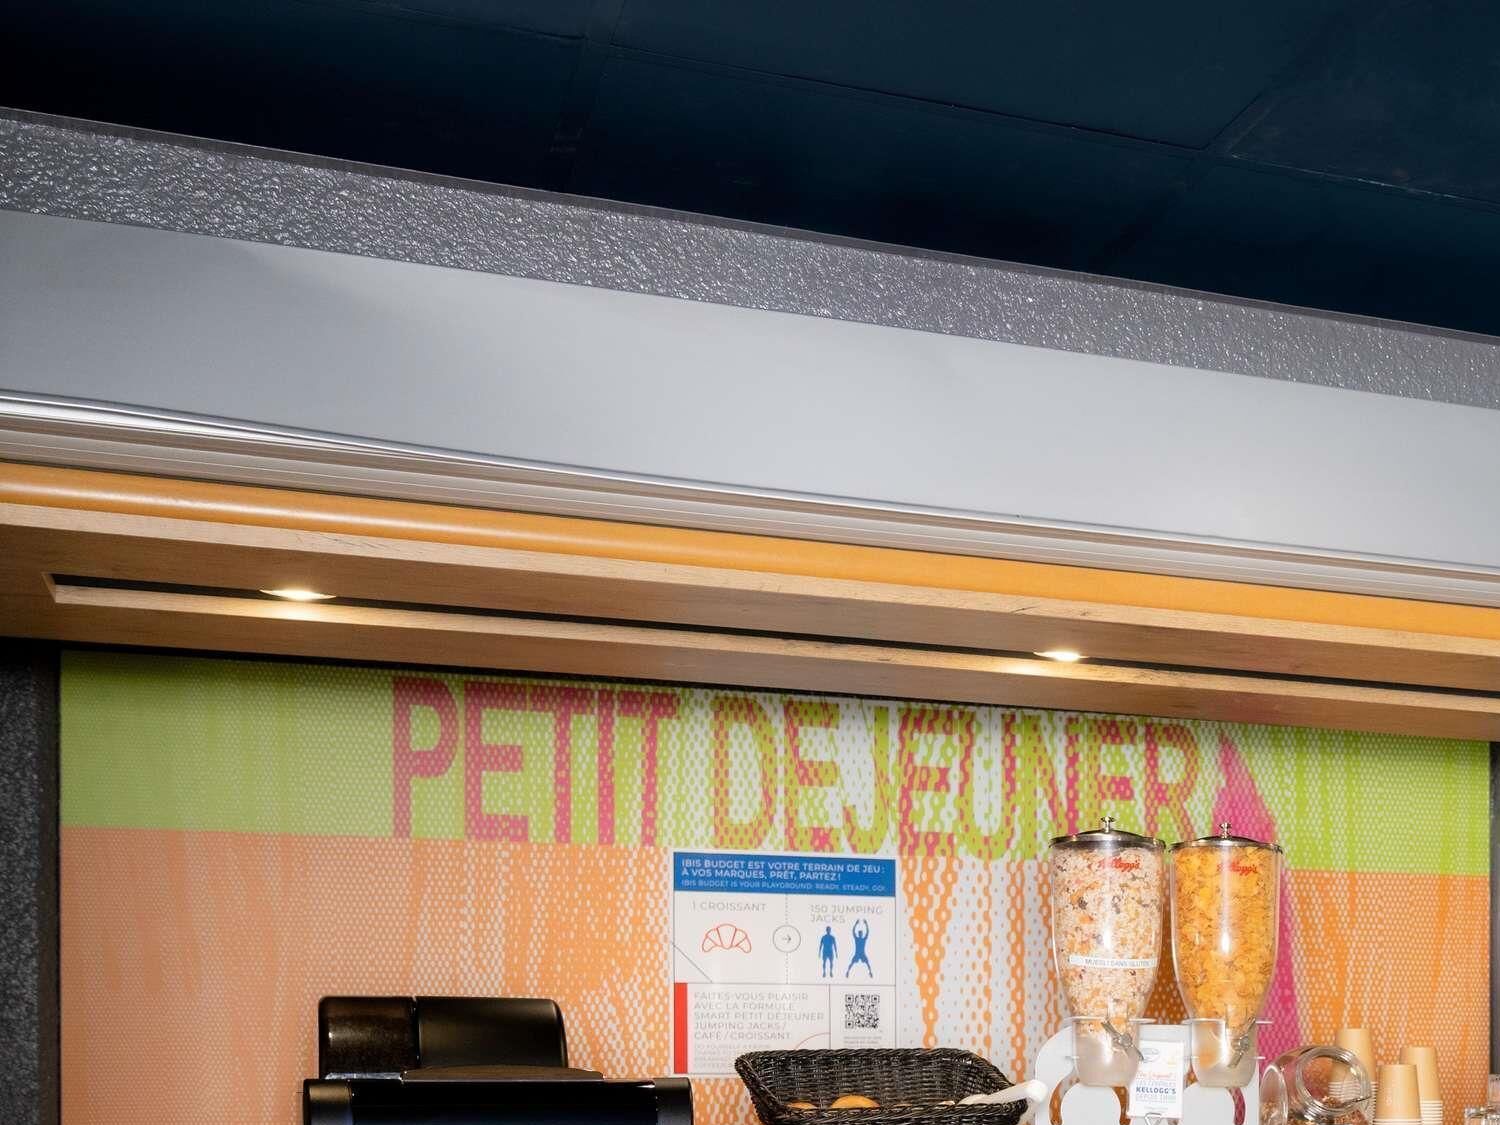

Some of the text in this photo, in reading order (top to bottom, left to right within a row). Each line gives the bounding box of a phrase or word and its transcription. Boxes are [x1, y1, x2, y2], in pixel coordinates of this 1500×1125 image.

[392, 677, 1202, 860] PETIT DEJEUNER
[681, 858, 702, 868] IBIS
[704, 859, 745, 870] BUDGET
[747, 861, 766, 870] EST
[767, 861, 800, 871] VOTRE
[801, 863, 845, 873] TERRAIN
[846, 863, 861, 873] DE
[691, 868, 713, 878] VOS
[714, 869, 768, 880] MARQUES,
[769, 870, 797, 881] PRÊT,
[738, 881, 760, 889] YOUR
[699, 902, 768, 912] CROISSANT
[809, 904, 884, 915] 150 JUMPING
[808, 914, 847, 924] JACKS
[693, 1001, 794, 1011] AVEC LA FORMULE
[693, 1021, 744, 1031] JUMPING
